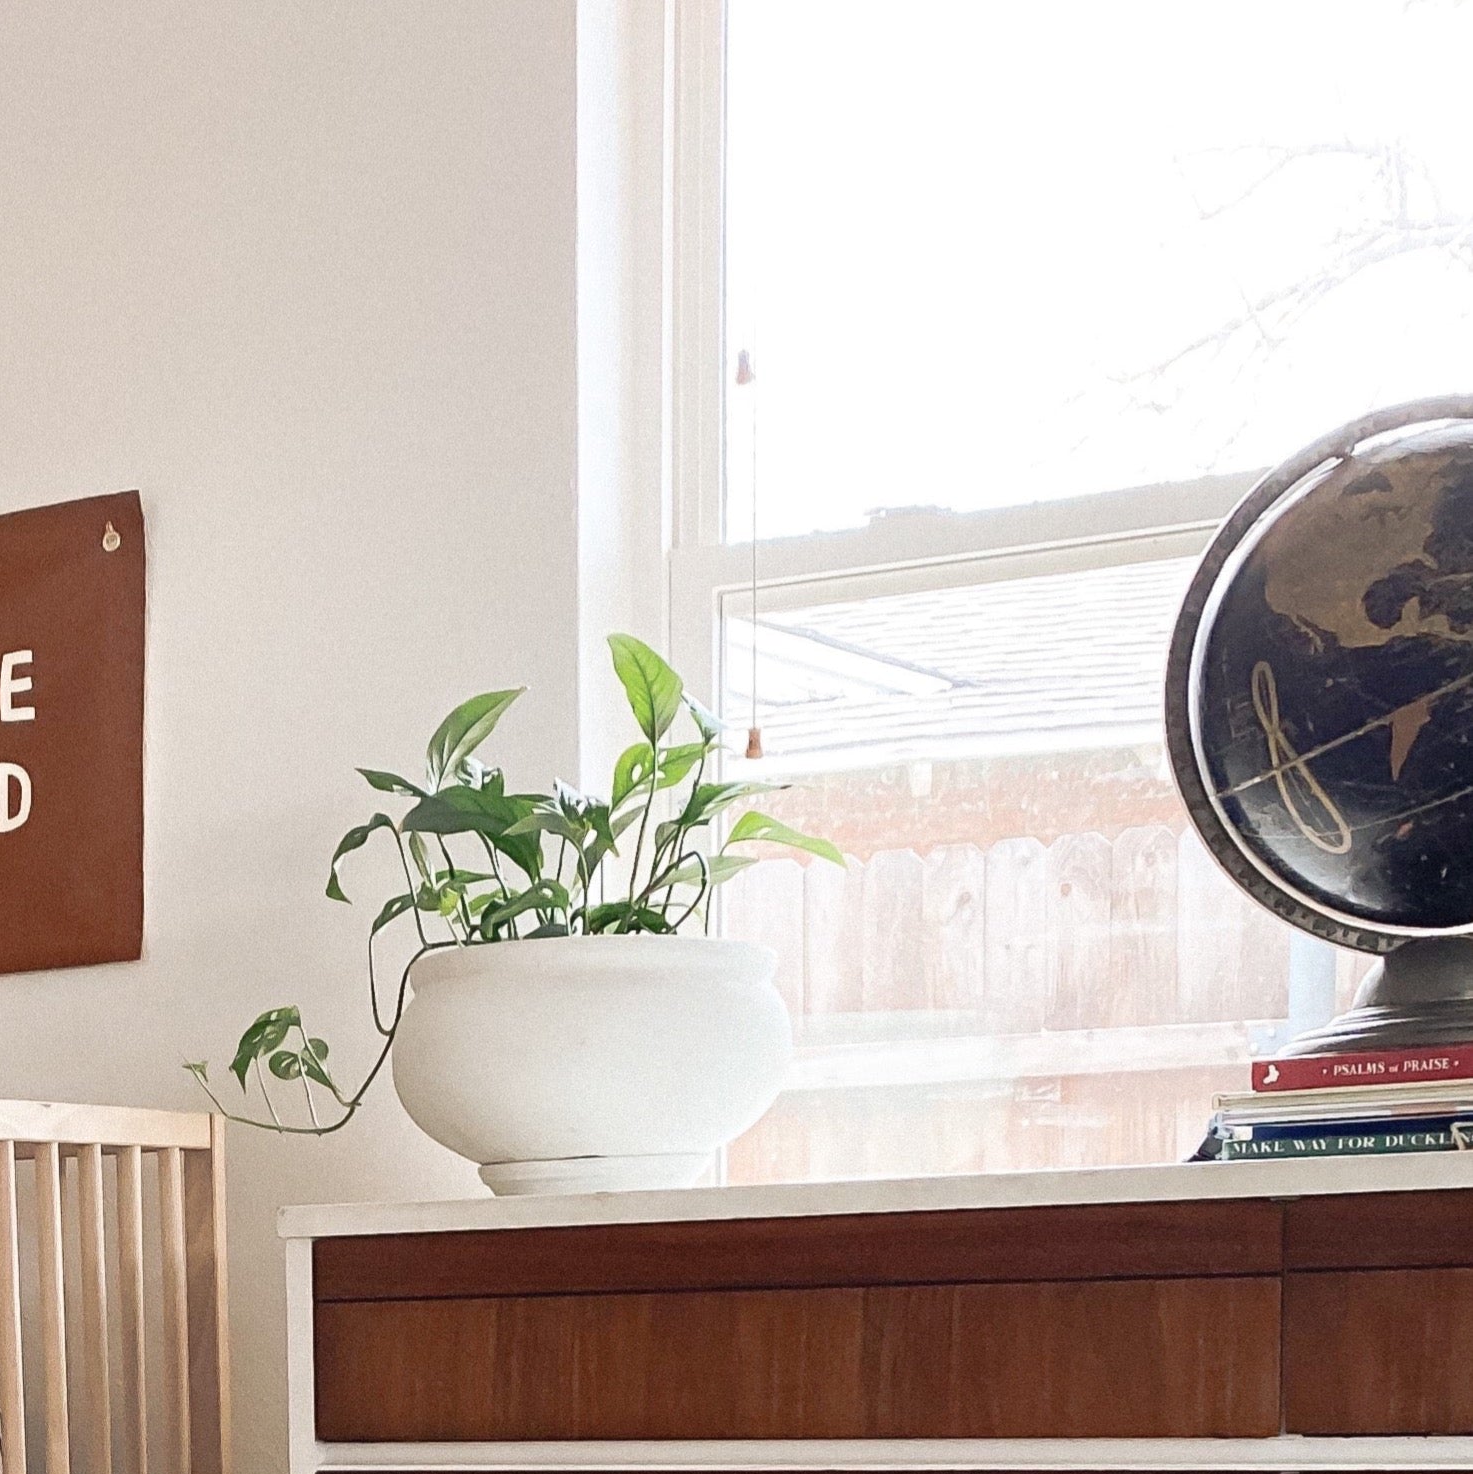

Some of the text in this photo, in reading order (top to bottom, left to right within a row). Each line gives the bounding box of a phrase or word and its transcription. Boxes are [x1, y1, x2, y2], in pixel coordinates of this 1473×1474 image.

[1333, 1062, 1385, 1076] PSALMS
[1403, 1057, 1450, 1073] PRAISE
[1232, 1141, 1284, 1154] MAKE
[1292, 1138, 1326, 1151] WAY
[1338, 1135, 1376, 1149] FOR
